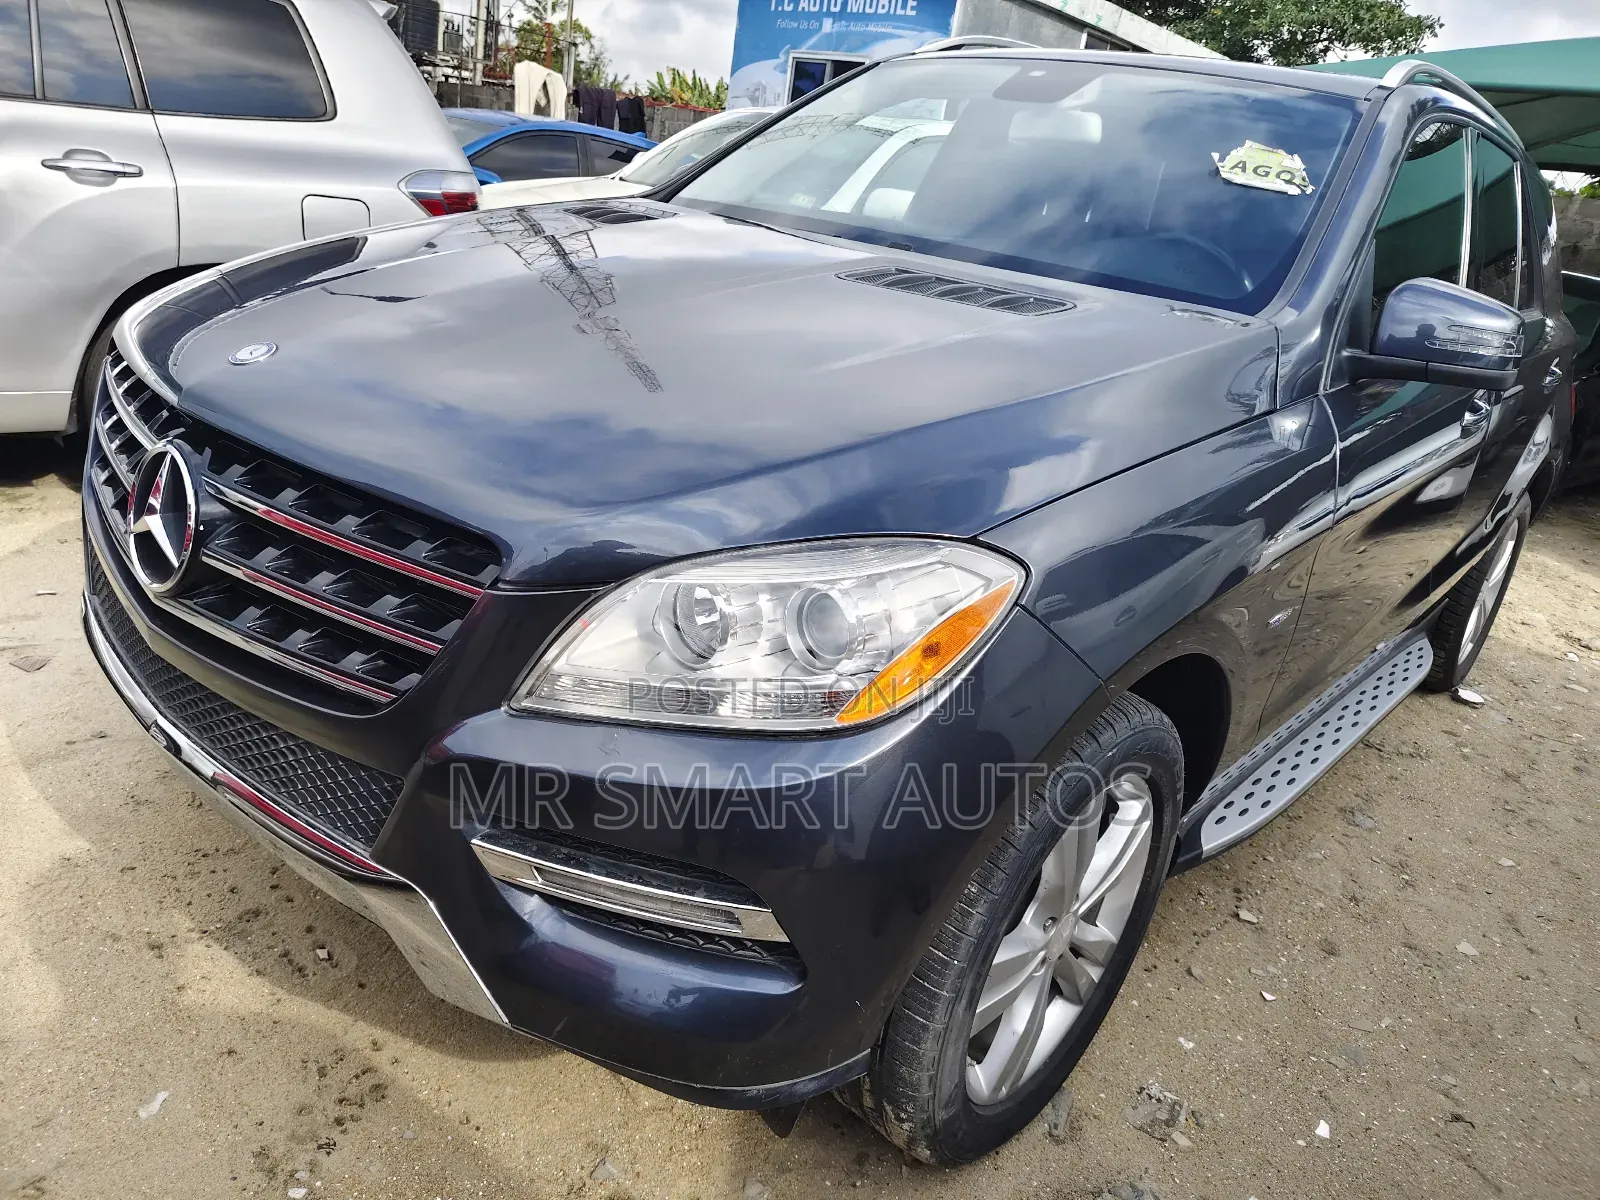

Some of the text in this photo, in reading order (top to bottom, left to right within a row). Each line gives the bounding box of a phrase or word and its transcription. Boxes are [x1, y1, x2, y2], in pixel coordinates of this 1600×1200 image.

[797, 0, 842, 13] AUTO
[847, 0, 917, 16] MOBILE
[776, 18, 798, 29] Follow
[799, 20, 808, 29] Us
[809, 21, 819, 30] On
